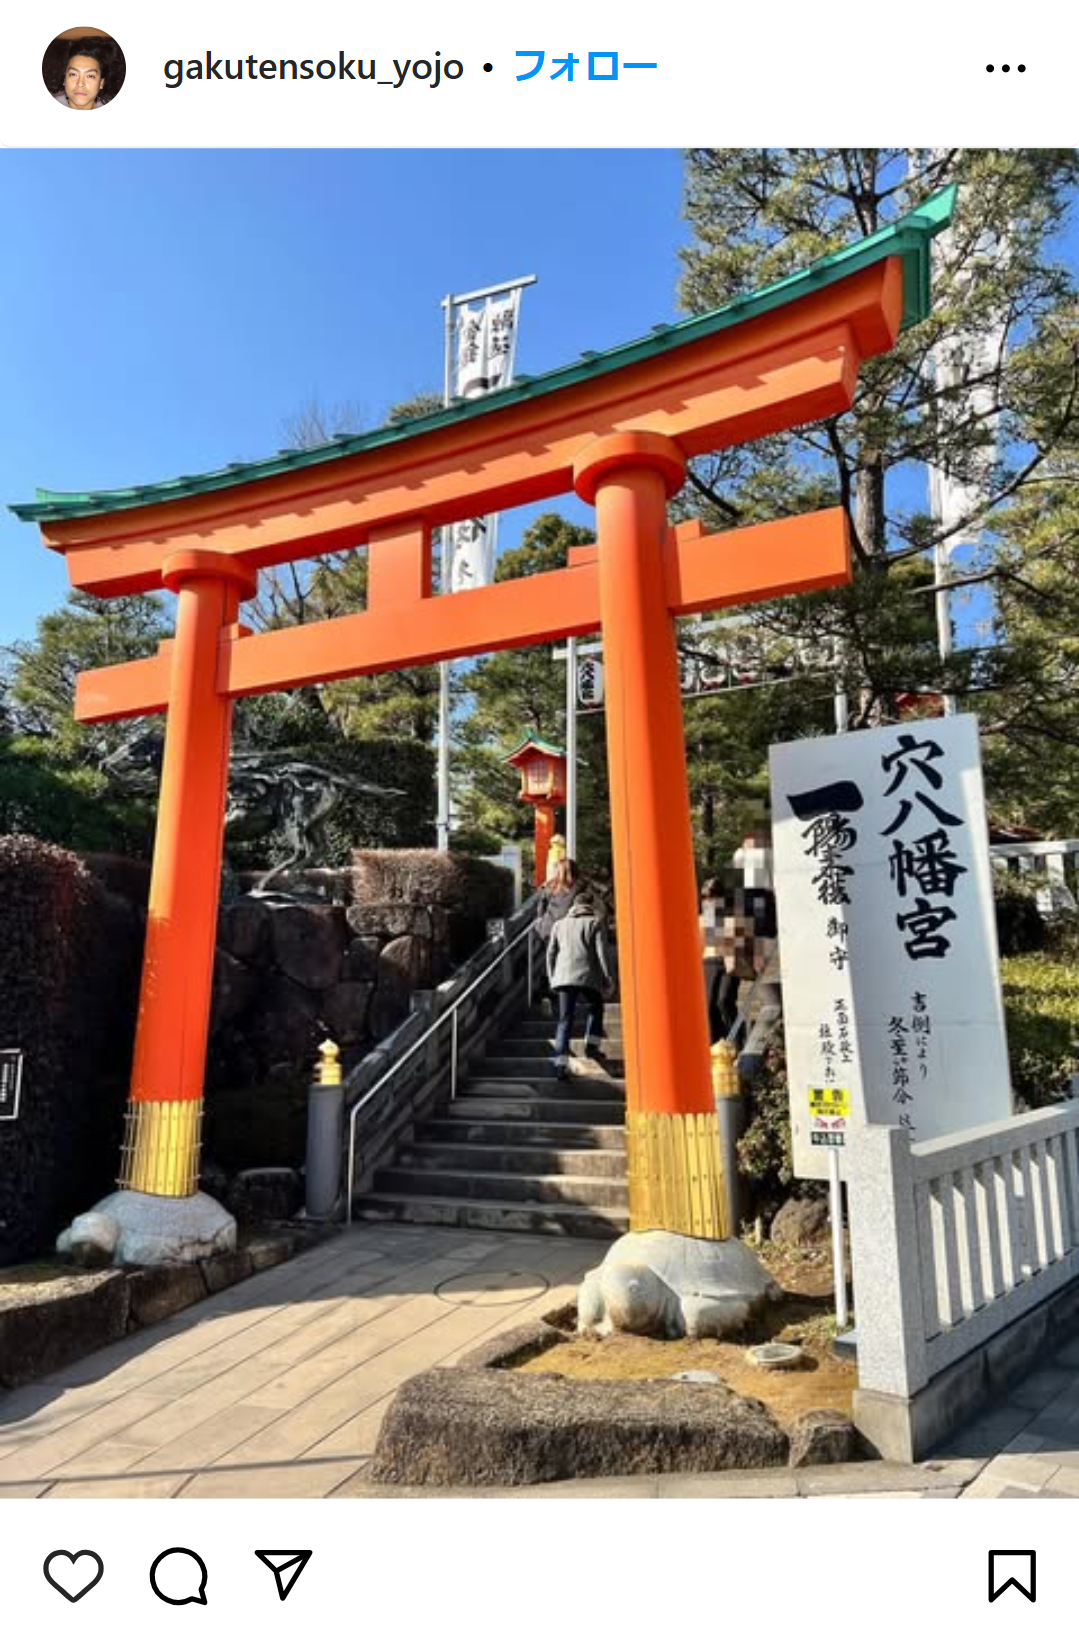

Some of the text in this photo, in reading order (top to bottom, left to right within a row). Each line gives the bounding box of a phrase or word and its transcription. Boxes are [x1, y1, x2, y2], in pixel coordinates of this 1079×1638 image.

[880, 734, 968, 961] 穴八幡宮
[911, 990, 931, 1079] 吉例により
